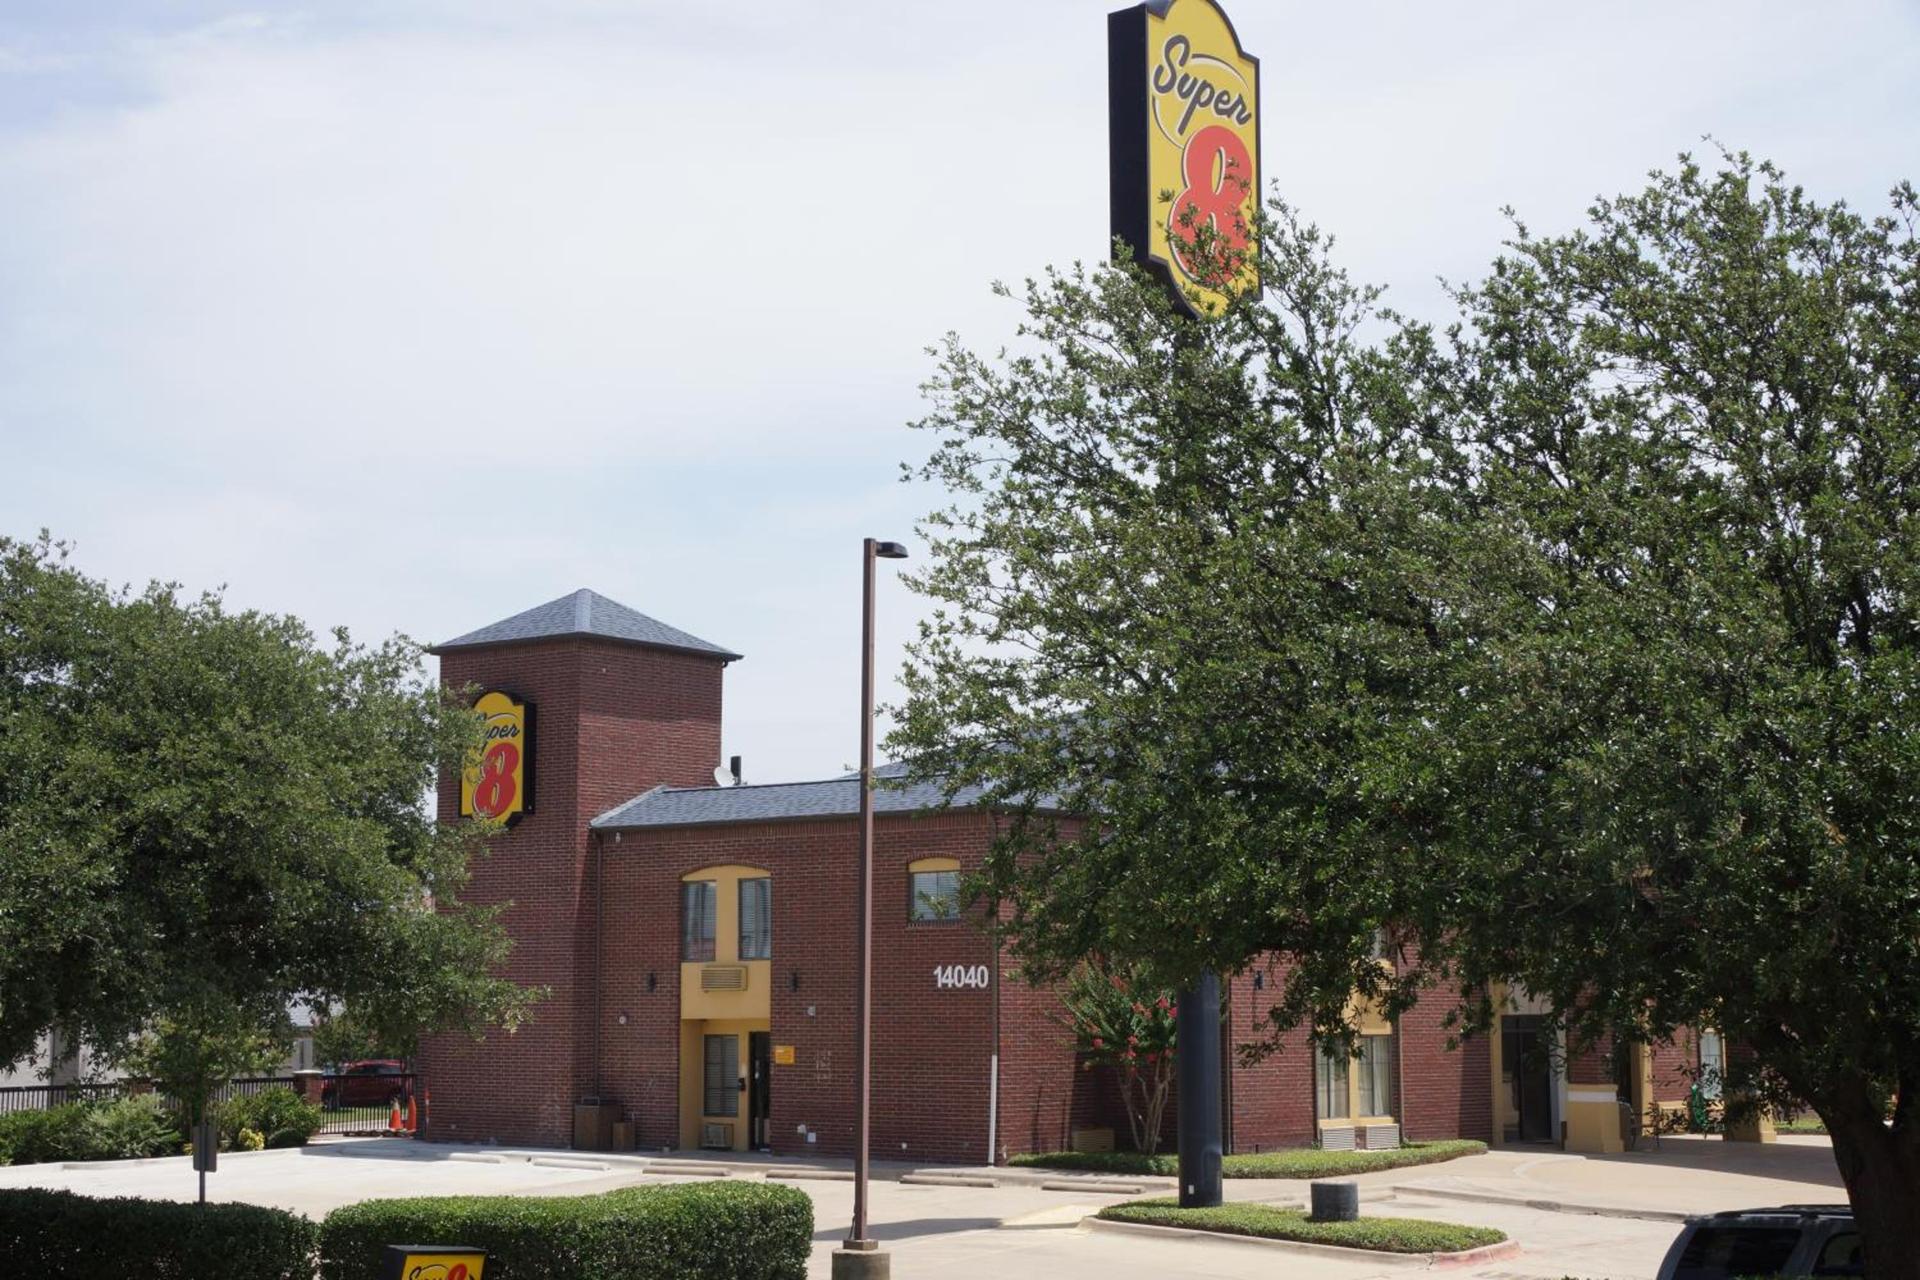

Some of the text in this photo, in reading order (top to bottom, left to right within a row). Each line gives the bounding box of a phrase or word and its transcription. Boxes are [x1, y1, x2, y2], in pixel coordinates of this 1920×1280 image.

[1153, 34, 1252, 136] Super
[1168, 125, 1253, 287] 8
[473, 742, 519, 818] 8
[933, 965, 989, 988] 14040
